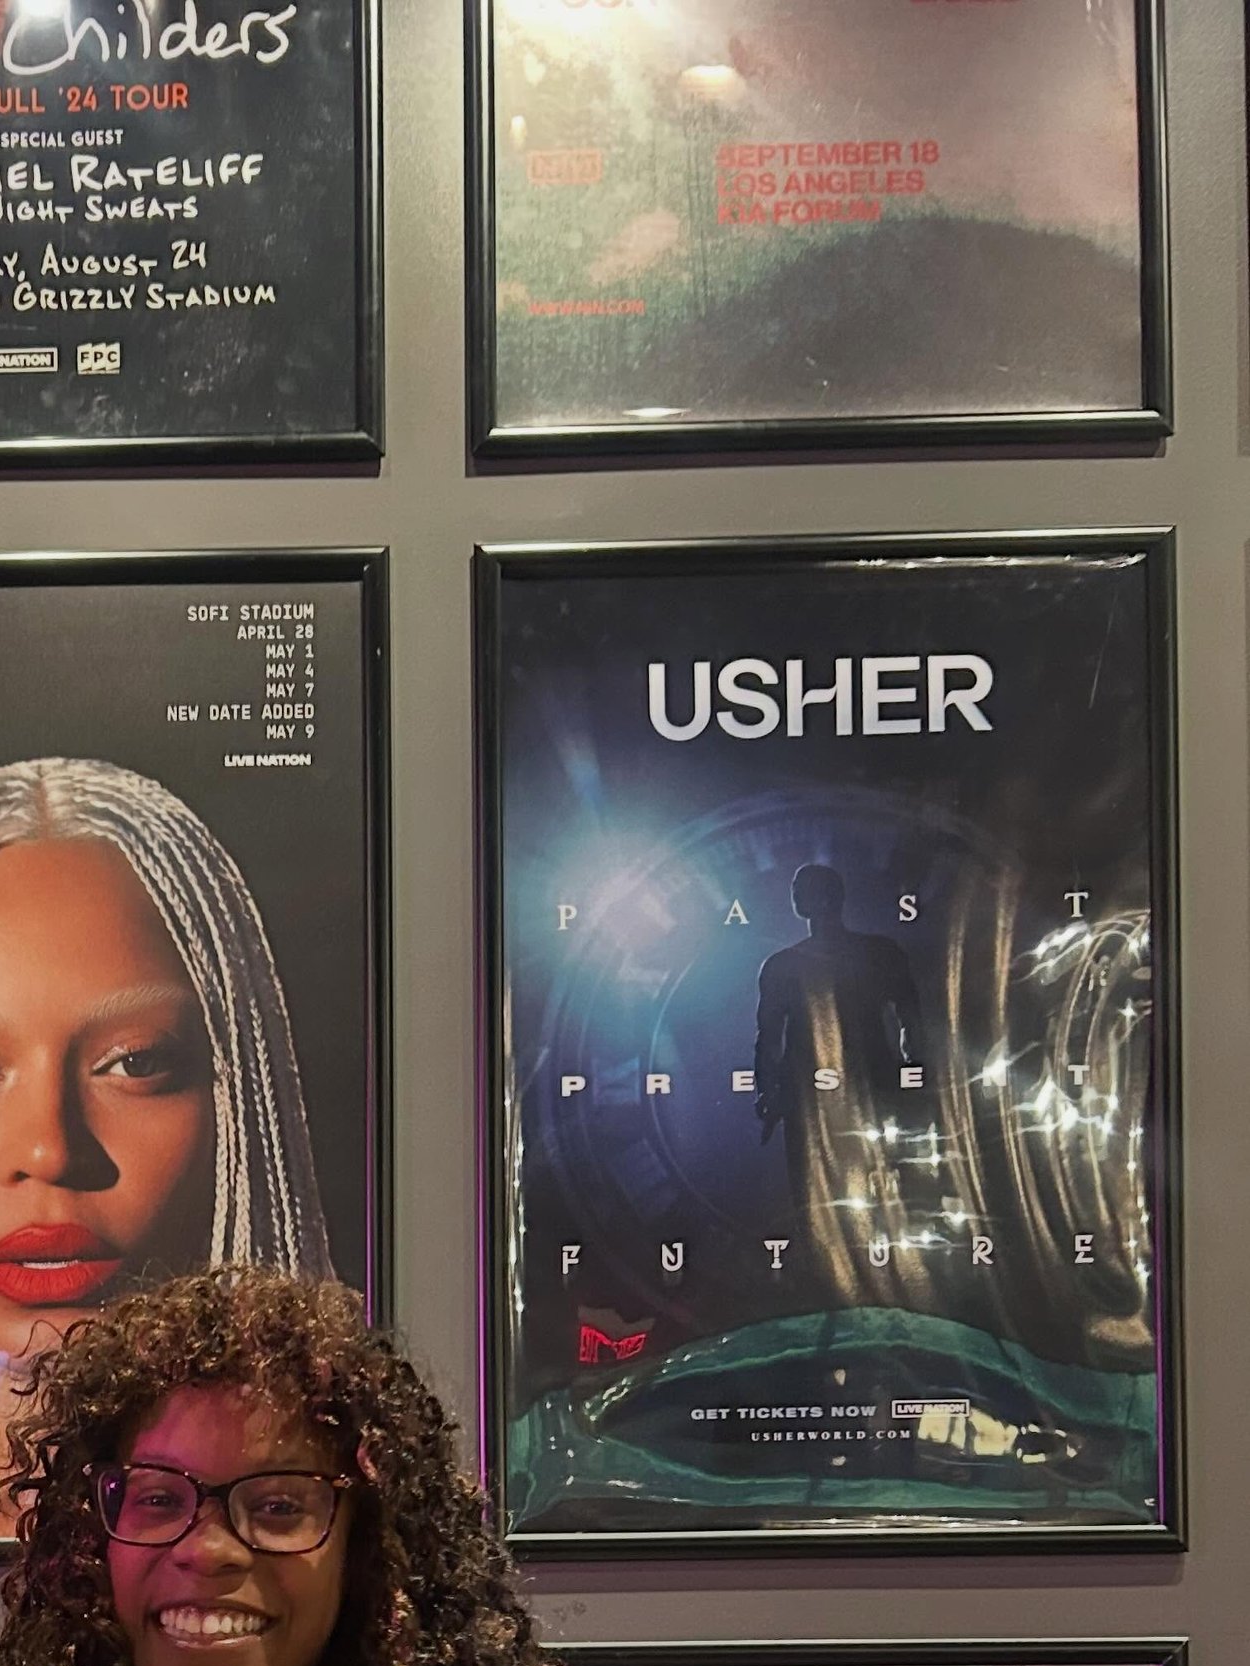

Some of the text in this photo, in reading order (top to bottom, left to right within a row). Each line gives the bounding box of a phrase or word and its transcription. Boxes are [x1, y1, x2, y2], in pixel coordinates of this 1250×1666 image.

[58, 86, 98, 113] '24
[110, 83, 189, 110] TOUR
[0, 130, 66, 149] SPECIAL
[71, 129, 124, 147] GUEST
[715, 141, 940, 168] SEPTEMBER 18
[70, 152, 264, 195] RATELIFF
[716, 169, 926, 197] LOS ANGELES
[85, 196, 199, 222] SWEATS
[717, 199, 881, 226] KIA FORUM
[41, 243, 158, 277] AUGUST
[171, 239, 207, 270] 24
[12, 281, 136, 313] GRIZZLY
[146, 284, 277, 309] STADIUM
[0, 353, 51, 368] NATION
[80, 351, 118, 364] FPC
[187, 603, 314, 621] SOFI STADIUM
[237, 624, 314, 640] APRIL 28
[265, 643, 314, 659] MAY 1
[265, 663, 314, 679] MAY 4
[266, 683, 314, 698] MAY 7
[647, 653, 994, 742] USHER
[166, 703, 314, 722] NEW DATE ADDED
[266, 724, 315, 739] MAY 9
[224, 753, 311, 767] LIVE NATION
[556, 890, 1090, 931] PAST
[561, 1064, 1091, 1097] PRESENT
[690, 1405, 877, 1421] GET TICKETS NOW
[897, 1402, 967, 1415] LIVE NATION
[751, 1429, 912, 1442] USHERWORLD.COM
